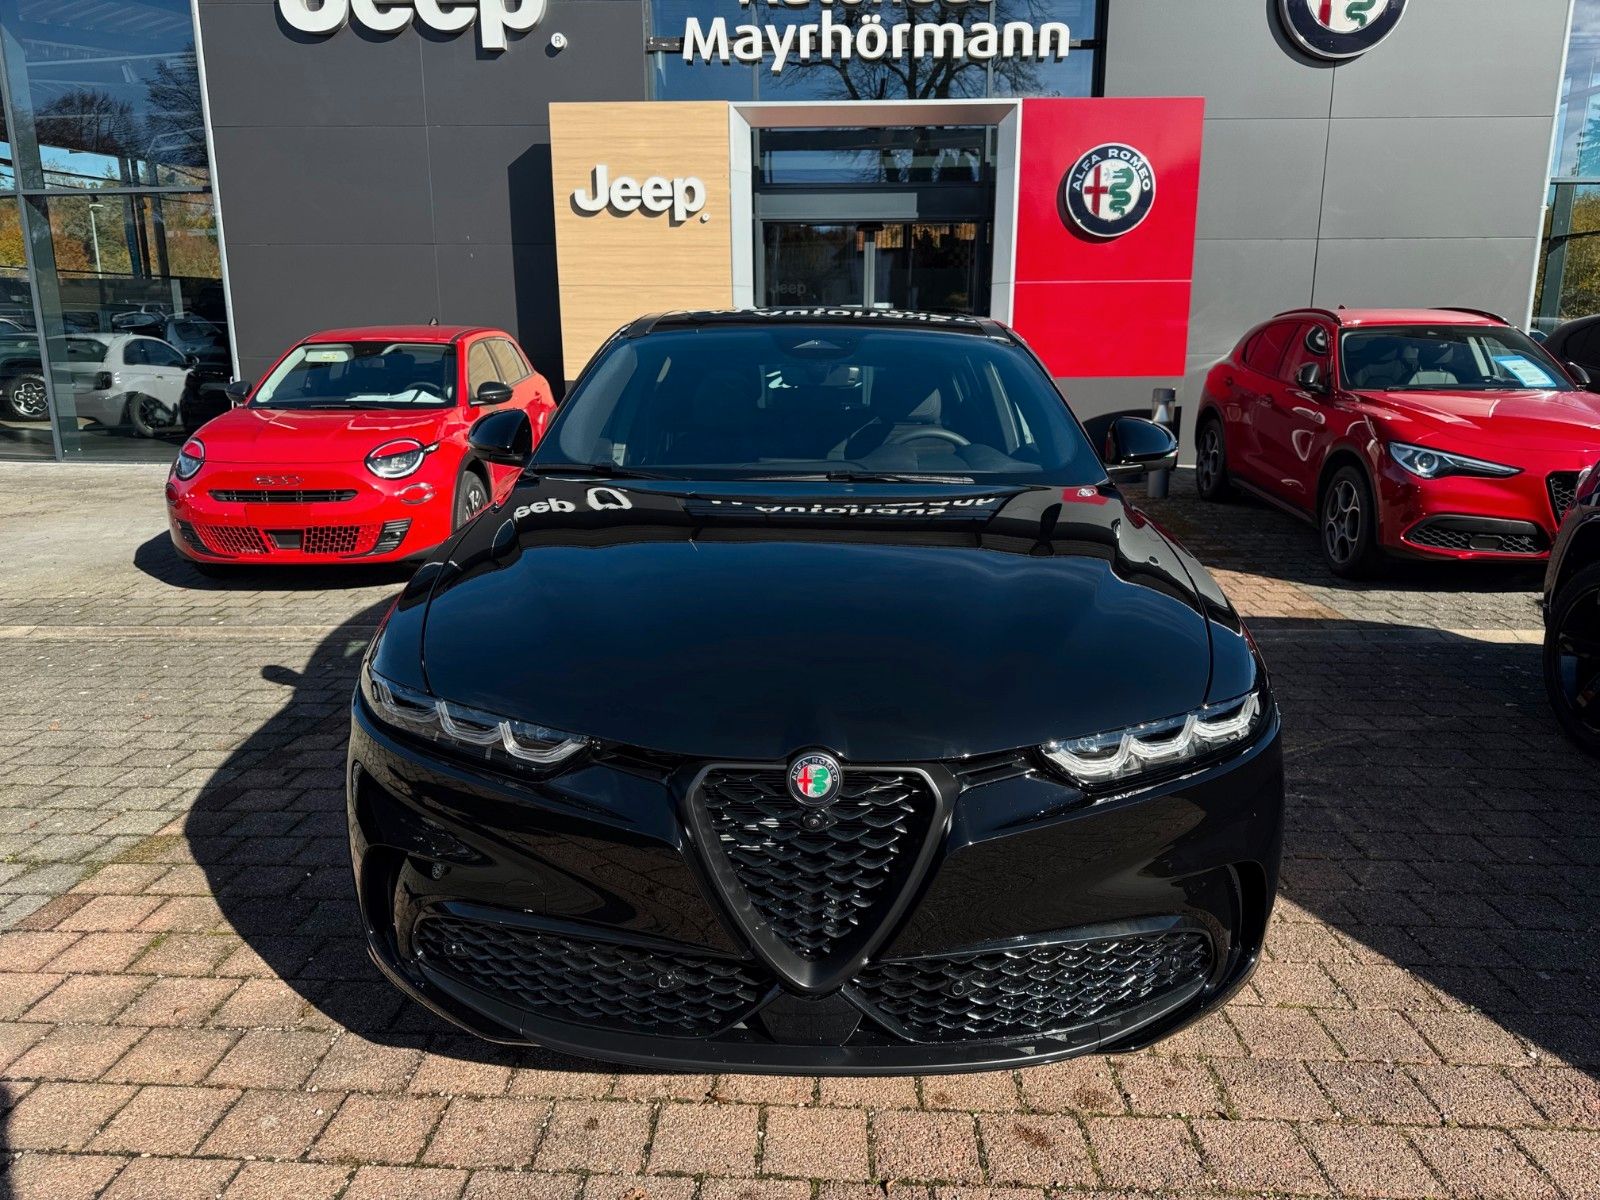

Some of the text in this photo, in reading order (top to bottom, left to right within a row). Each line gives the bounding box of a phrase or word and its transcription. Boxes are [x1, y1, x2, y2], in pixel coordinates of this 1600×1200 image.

[682, 10, 1070, 71] Mayrhörmann
[574, 164, 706, 221] Jeep
[1072, 148, 1151, 192] ALFA ROMEO
[791, 757, 838, 782] ALFA ROMEO
